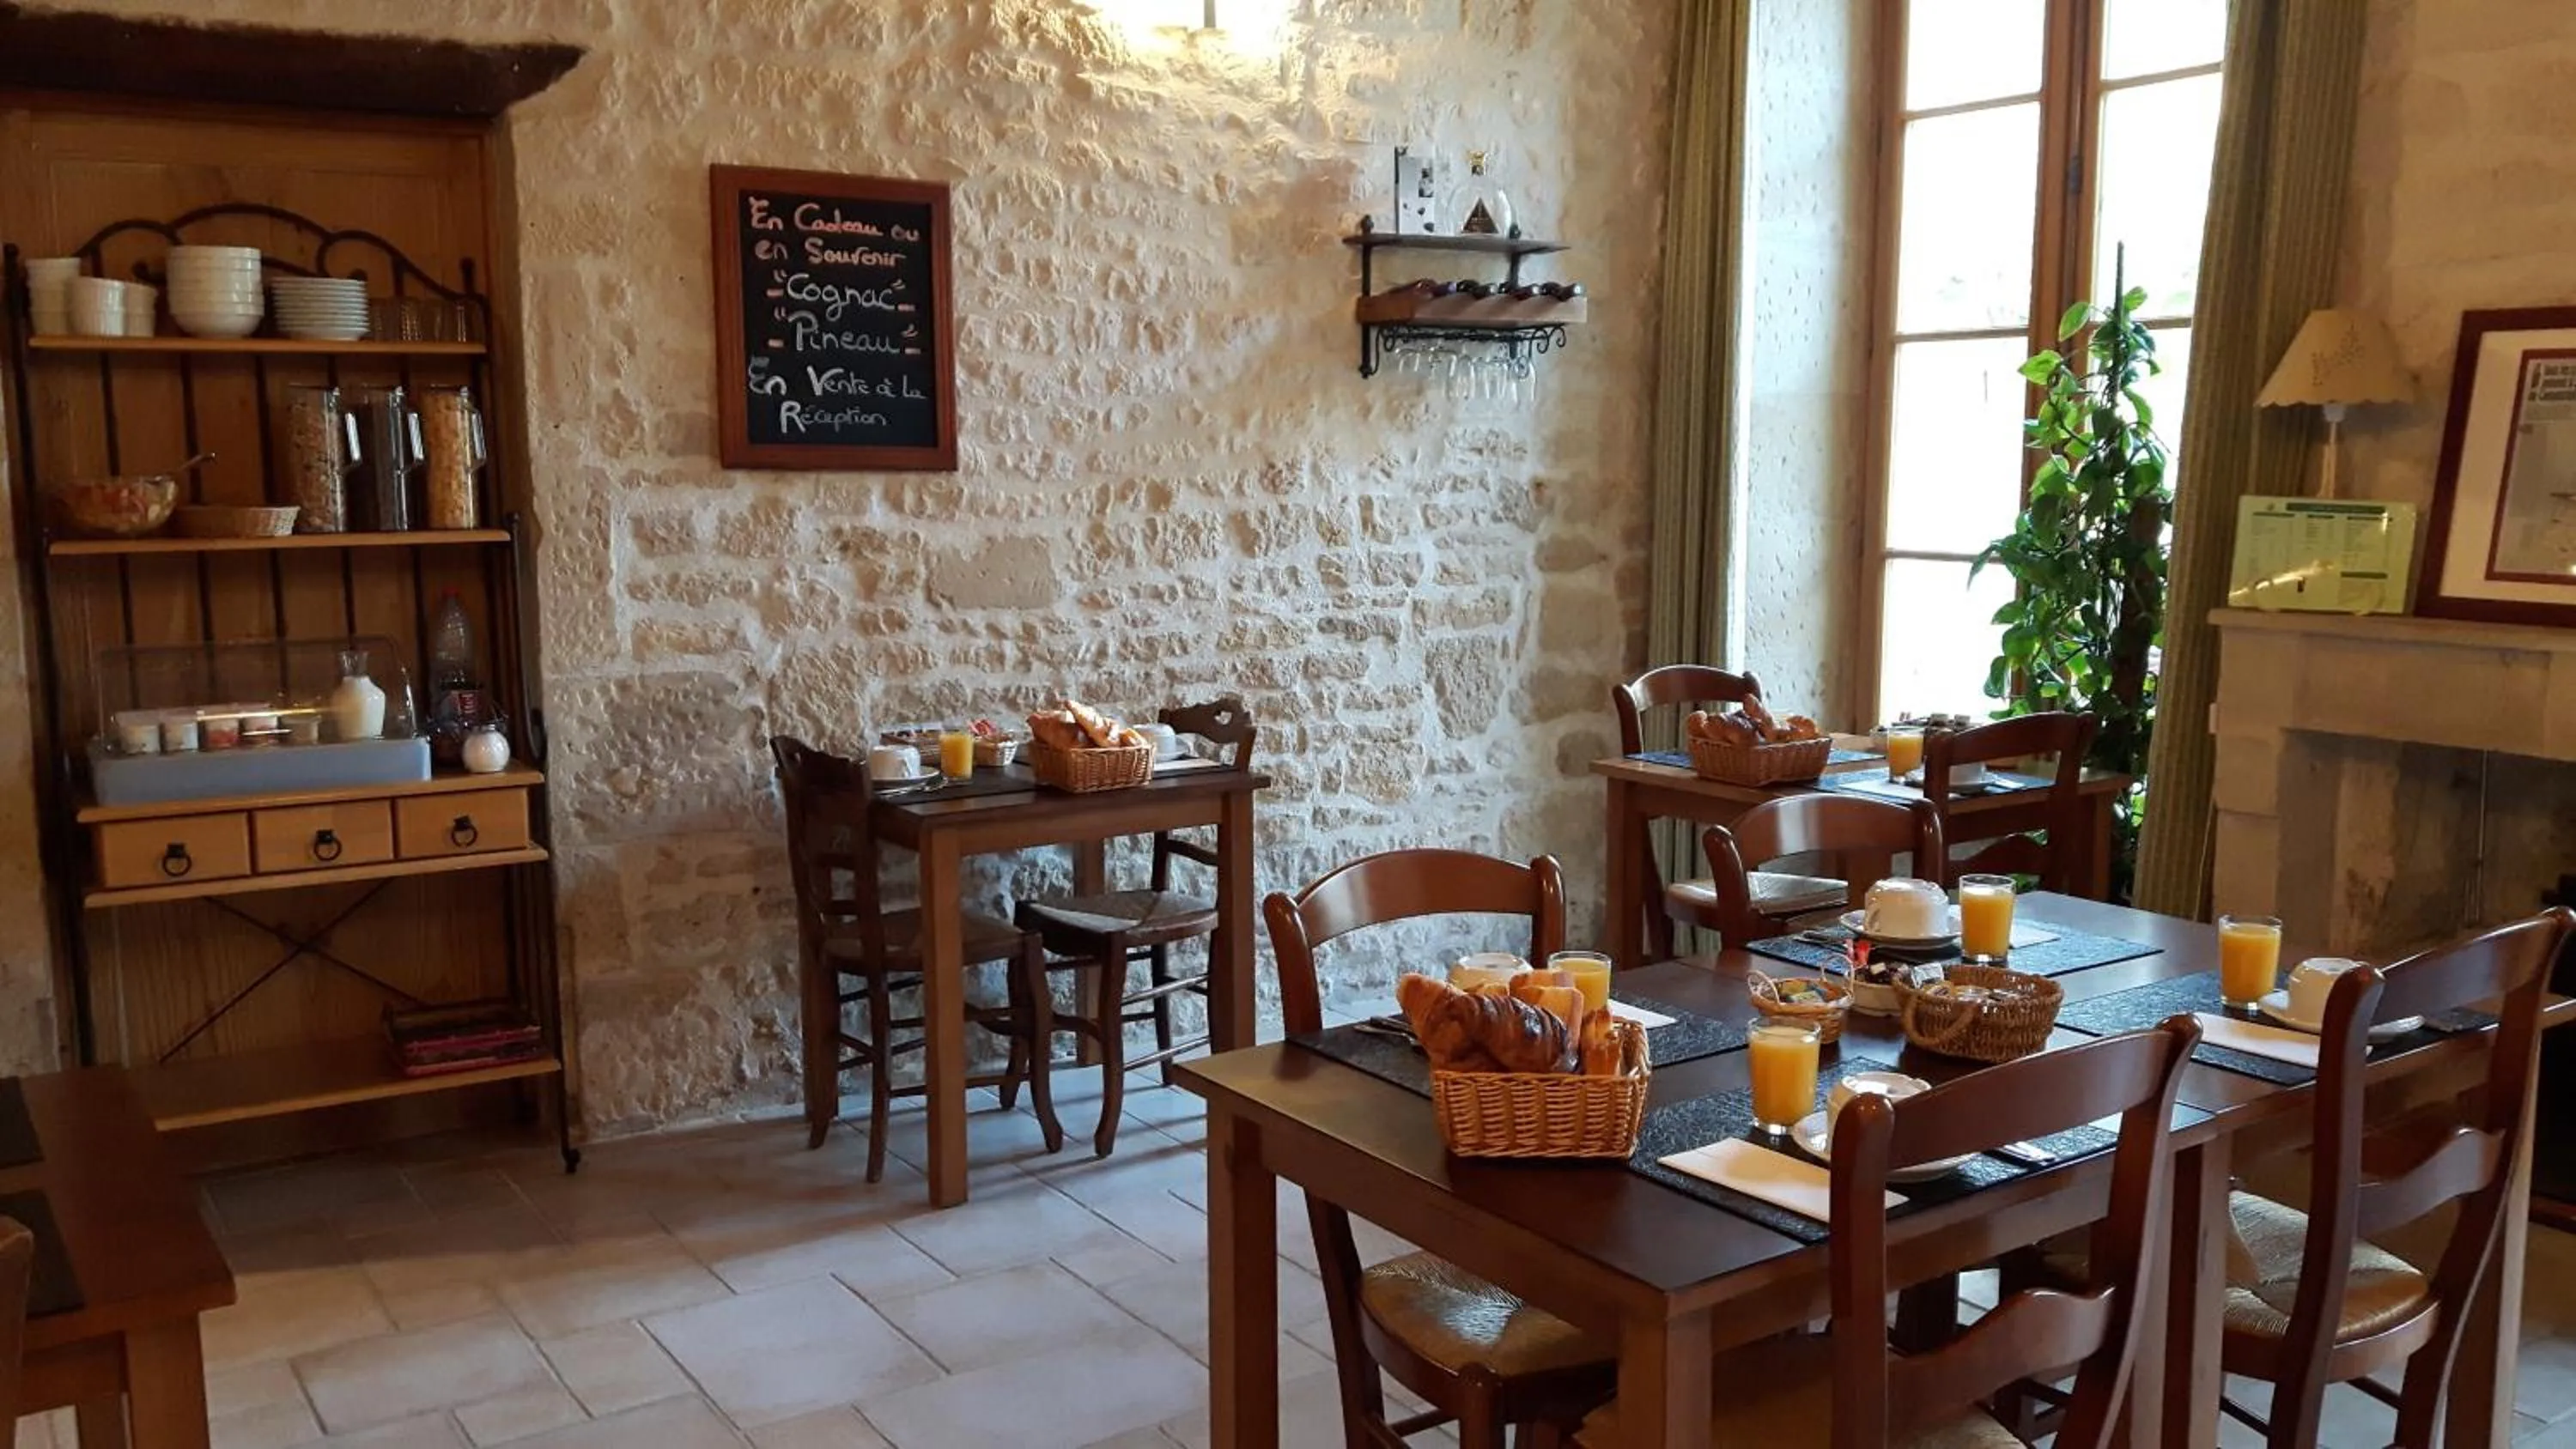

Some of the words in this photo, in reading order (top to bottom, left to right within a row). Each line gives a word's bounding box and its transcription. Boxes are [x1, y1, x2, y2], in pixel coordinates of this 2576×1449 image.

[749, 196, 783, 231] En
[794, 203, 884, 238] Cadeau
[890, 224, 920, 242] ou
[755, 239, 788, 260] en
[804, 236, 908, 268] Souvenir
[748, 355, 787, 396] En
[806, 365, 870, 396] Vente
[780, 400, 887, 433] Réception
